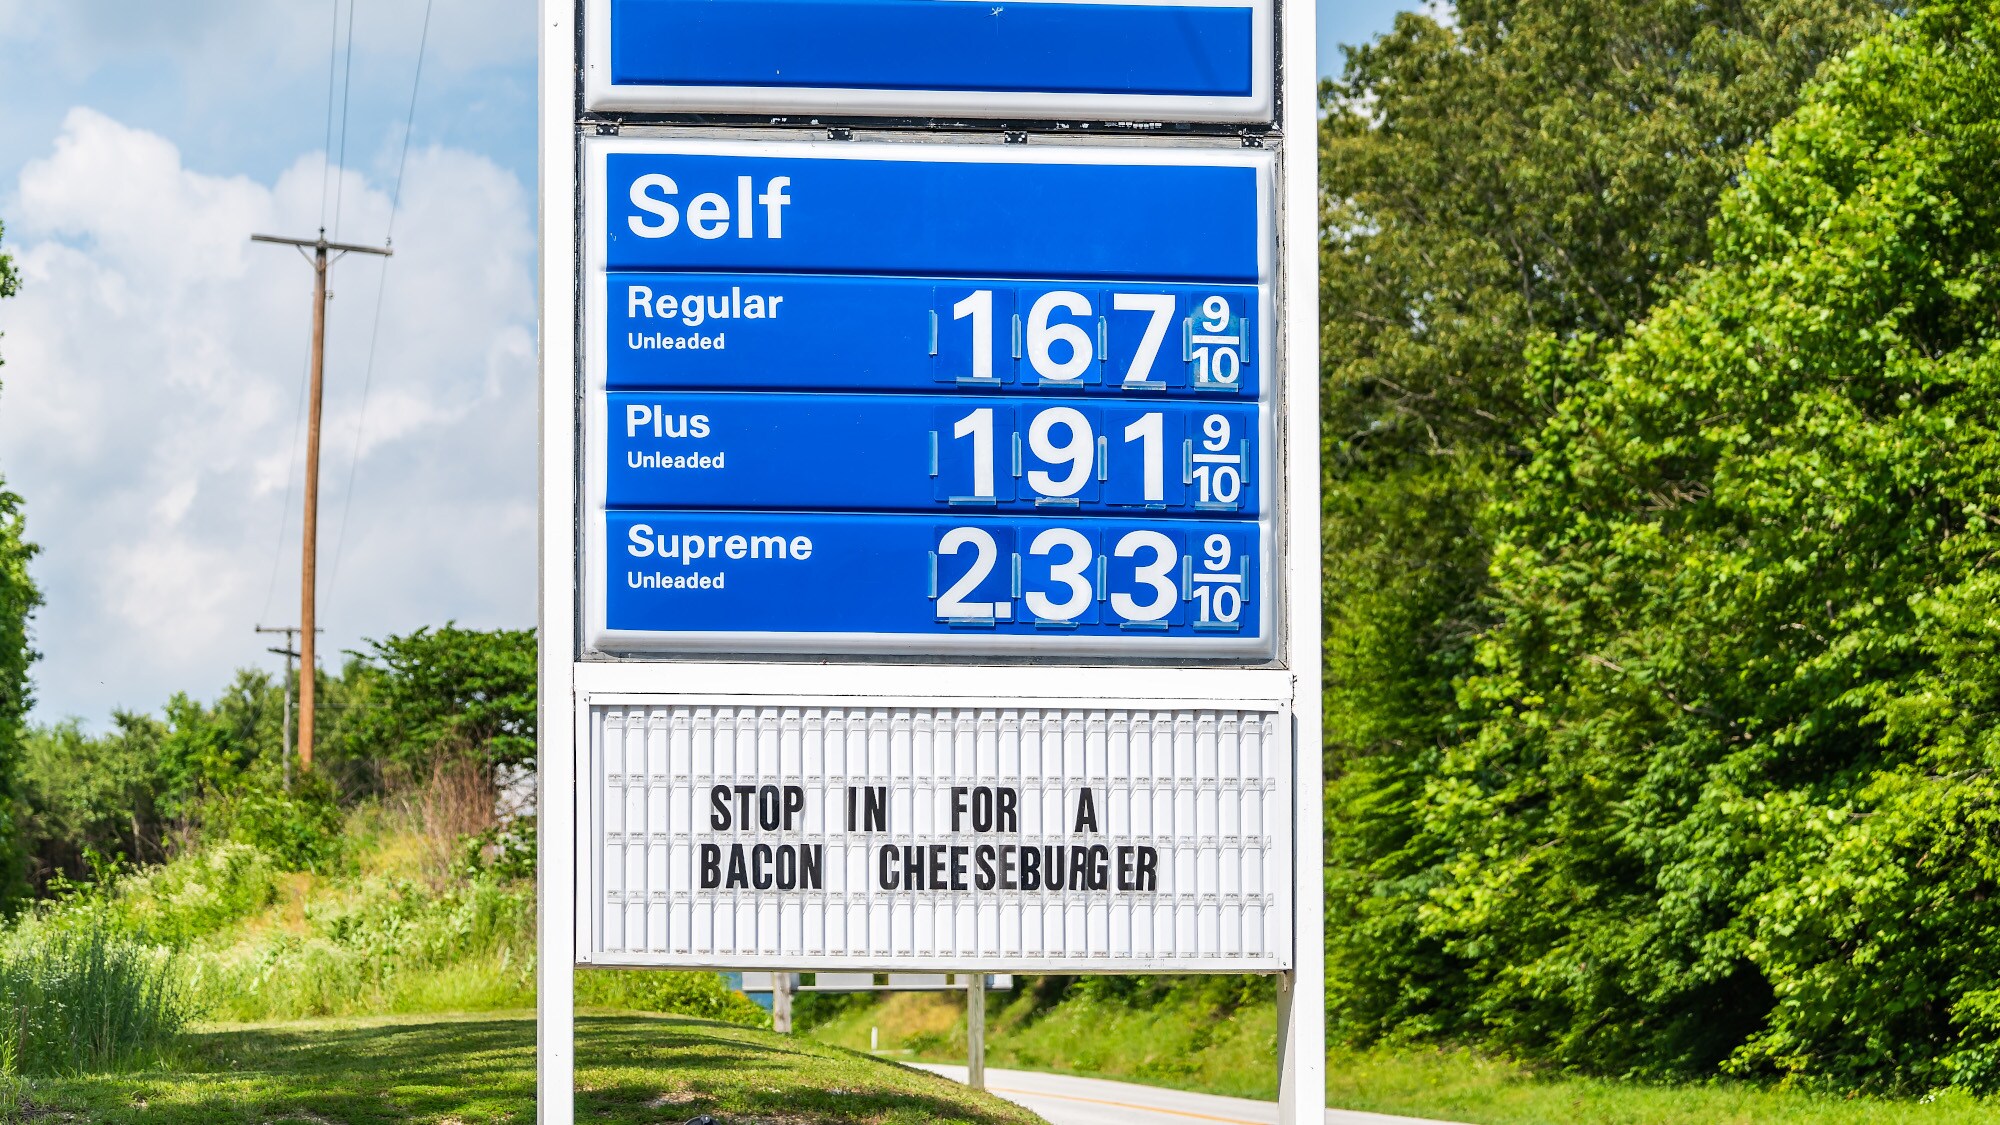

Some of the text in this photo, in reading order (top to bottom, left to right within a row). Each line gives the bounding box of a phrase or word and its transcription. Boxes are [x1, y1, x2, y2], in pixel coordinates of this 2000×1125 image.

[628, 174, 791, 240] Self
[628, 286, 783, 326] Regular
[628, 332, 725, 350] Unleaded
[953, 290, 1176, 383] 167
[627, 405, 711, 439] Plus
[628, 451, 725, 469] Unleaded
[954, 407, 1164, 501] 191
[628, 525, 813, 568] Supreme
[628, 571, 725, 589] Unleaded
[936, 527, 1178, 622] 2.33
[711, 785, 1098, 833] STOP IN FOR A
[700, 844, 1158, 892] BACON CHEESEBURGER
